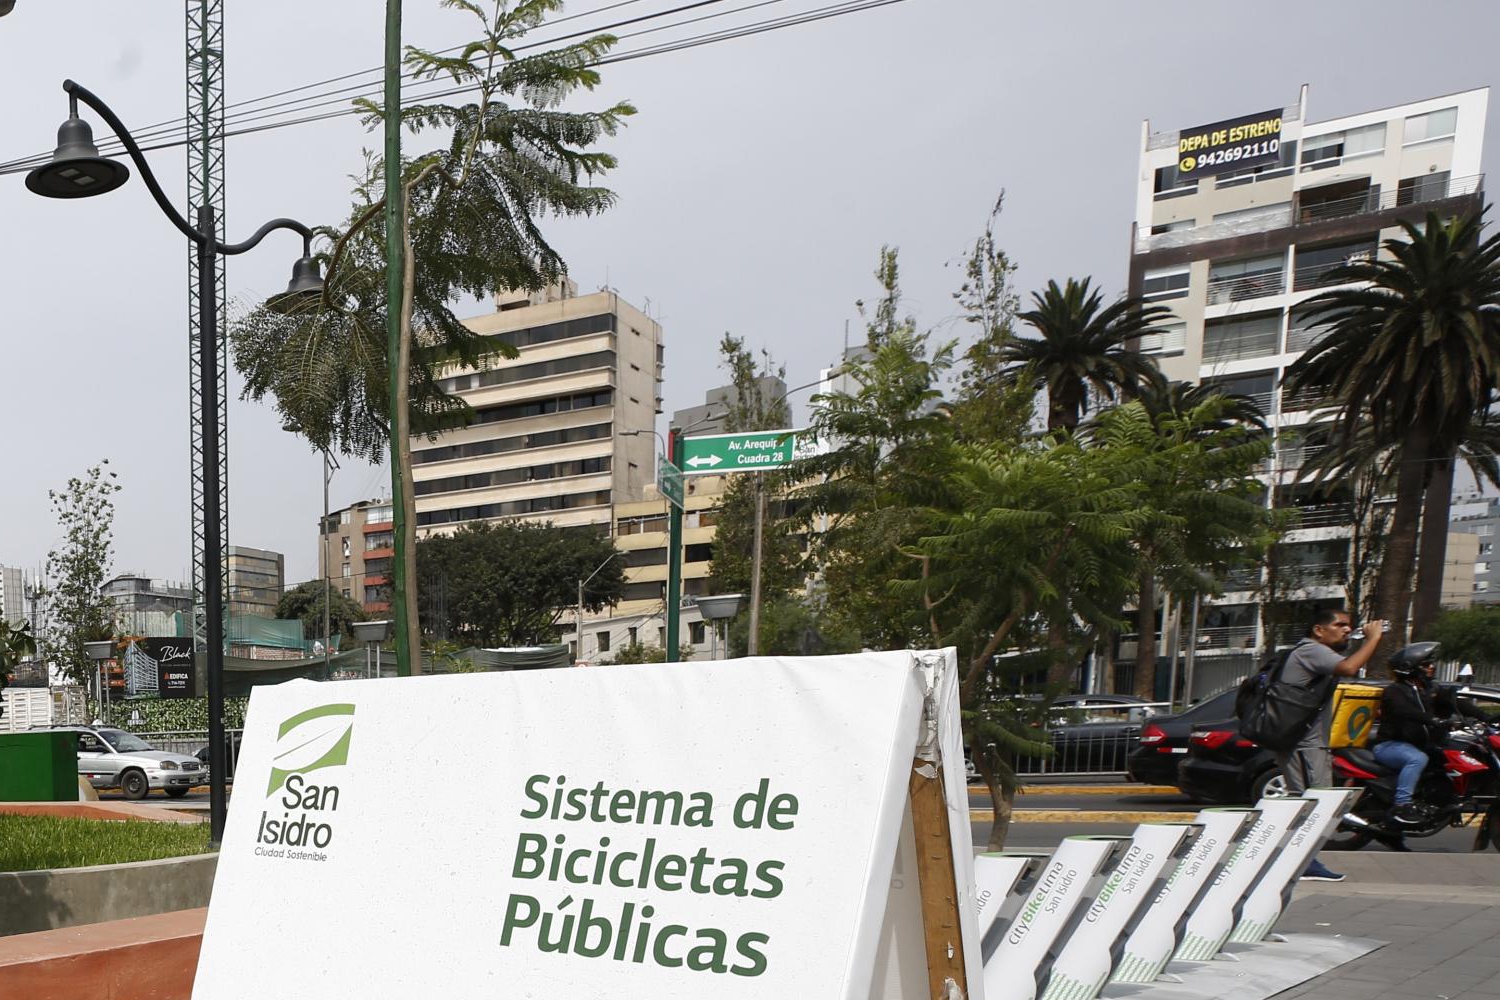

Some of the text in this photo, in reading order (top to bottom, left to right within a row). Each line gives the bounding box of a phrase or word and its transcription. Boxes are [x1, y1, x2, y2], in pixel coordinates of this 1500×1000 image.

[1180, 118, 1282, 153] DEPA DE ESTRENO
[1197, 139, 1279, 168] 942692110
[728, 440, 742, 451] Av.
[737, 452, 783, 464] Cuadra 28
[160, 646, 191, 662] Black
[282, 775, 339, 811] San
[520, 774, 799, 830] Sistema de
[257, 810, 332, 848] Isidro
[1245, 823, 1276, 860] San Isidro
[1291, 812, 1320, 848] San Isidro
[254, 847, 327, 862] Ciudad Sostenible
[512, 832, 786, 899] Bicicletas
[1185, 837, 1217, 878] San Isidro
[1045, 869, 1077, 915] San Isidro
[1086, 845, 1142, 924] CityBikeLima
[1122, 852, 1155, 895] San Isidro
[977, 888, 992, 916] sidro
[1008, 860, 1064, 945] CityBikeLima
[500, 893, 770, 977] Públicas
